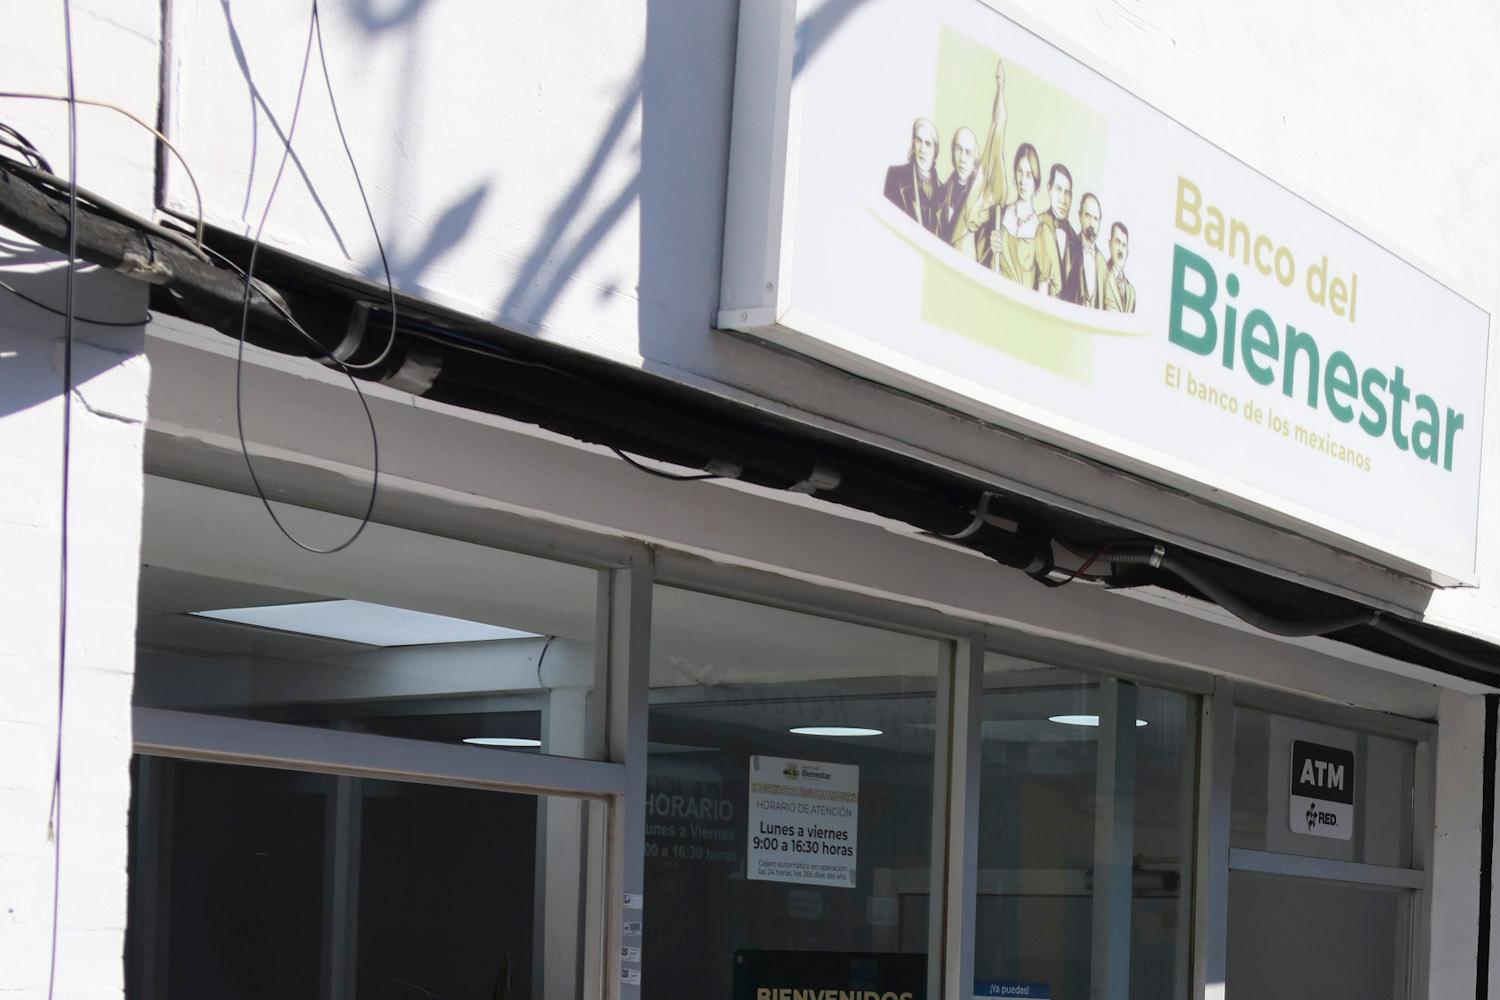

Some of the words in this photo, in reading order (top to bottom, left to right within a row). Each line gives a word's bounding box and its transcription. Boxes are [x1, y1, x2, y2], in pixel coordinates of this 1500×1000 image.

[1174, 175, 1296, 288] Banco
[1306, 255, 1358, 324] del
[1168, 242, 1465, 472] Bienestar
[1164, 362, 1182, 391] El
[1187, 371, 1239, 415] banco
[1243, 400, 1264, 425] de
[1267, 408, 1290, 437] los
[1294, 425, 1372, 472] mexicanos
[1300, 758, 1345, 791] ATM
[756, 799, 796, 813] HORARIO
[798, 803, 809, 814] DE
[811, 805, 853, 818] ATENCIÓN
[1318, 811, 1337, 827] RED
[760, 821, 795, 836] Lunes
[797, 827, 804, 837] a
[807, 825, 848, 841] viernes
[673, 844, 702, 859] 16:30
[753, 836, 778, 851] 9:00
[781, 841, 788, 852] a
[792, 840, 819, 854] 16:30
[822, 842, 853, 857] horas
[989, 984, 1001, 995] ¡Ya
[1001, 984, 1031, 996] puedes!
